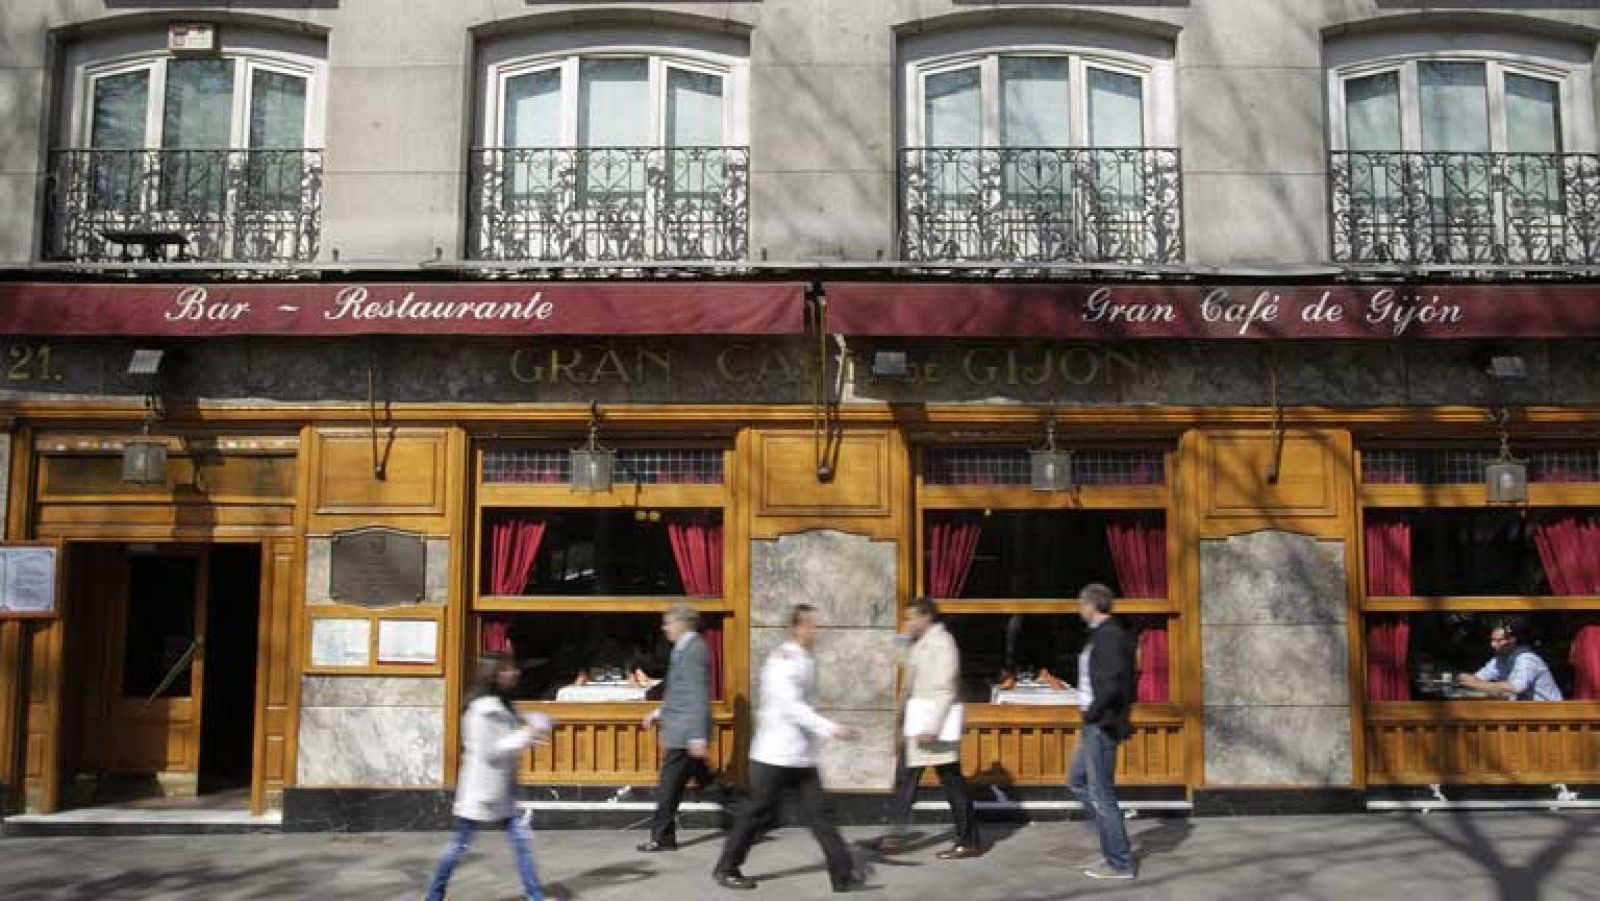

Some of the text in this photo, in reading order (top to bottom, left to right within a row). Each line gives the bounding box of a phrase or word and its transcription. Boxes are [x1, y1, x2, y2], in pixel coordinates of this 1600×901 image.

[164, 286, 250, 321] Bar
[324, 286, 554, 321] Restaurante
[1082, 286, 1464, 335] Gran Café de Gijón
[7, 345, 62, 381] 21.
[509, 348, 670, 384] GRAN
